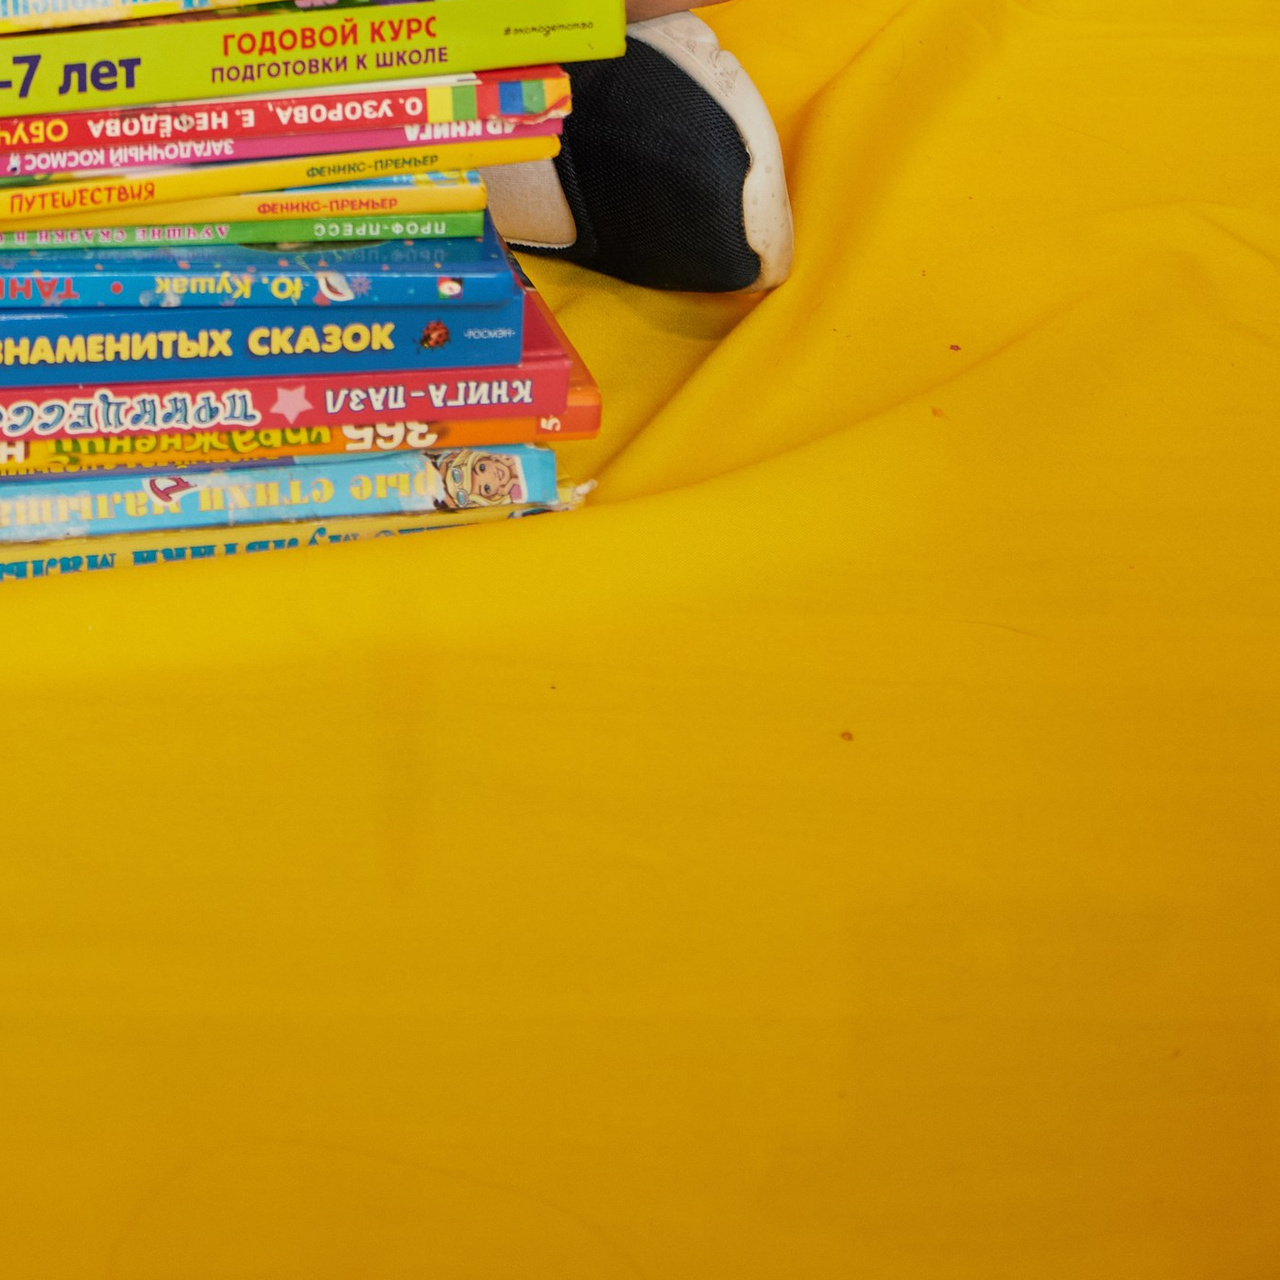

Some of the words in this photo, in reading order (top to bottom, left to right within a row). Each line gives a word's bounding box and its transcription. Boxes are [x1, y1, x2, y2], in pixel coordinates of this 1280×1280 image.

[222, 17, 359, 57] ГОДОВОЙ
[372, 15, 437, 44] КУРС
[58, 57, 142, 96] лет
[211, 53, 349, 84] ПОДГОТОВКИ
[357, 53, 368, 70] К
[376, 46, 448, 69] ШКОЛЕ
[235, 108, 256, 128] Е.
[267, 98, 393, 127] УЗОРОВА,
[399, 97, 423, 116] О.
[87, 109, 229, 140] НЕФЁДОВА
[404, 120, 483, 142] КНИГА
[24, 147, 106, 171] КОСМОС
[110, 138, 235, 168] ЗАГАДОЧНЫЙ
[306, 155, 439, 179] ФЕНИКС-ПРЕМЬЕР
[10, 182, 156, 215] ПУТЕШЕСТВИЯ
[257, 197, 399, 215] ФЕНИКС-ПРЕМЬЕР
[36, 228, 128, 244] СКАЗКИ
[136, 225, 231, 243] ЛУЧШИЕ
[313, 221, 446, 238] ПРОФ-ПРЕСС
[155, 271, 252, 300] Кушак
[261, 276, 302, 300] Ю.
[247, 322, 396, 356] СКАЗОК
[341, 421, 440, 452] 365
[199, 477, 336, 512] стихи
